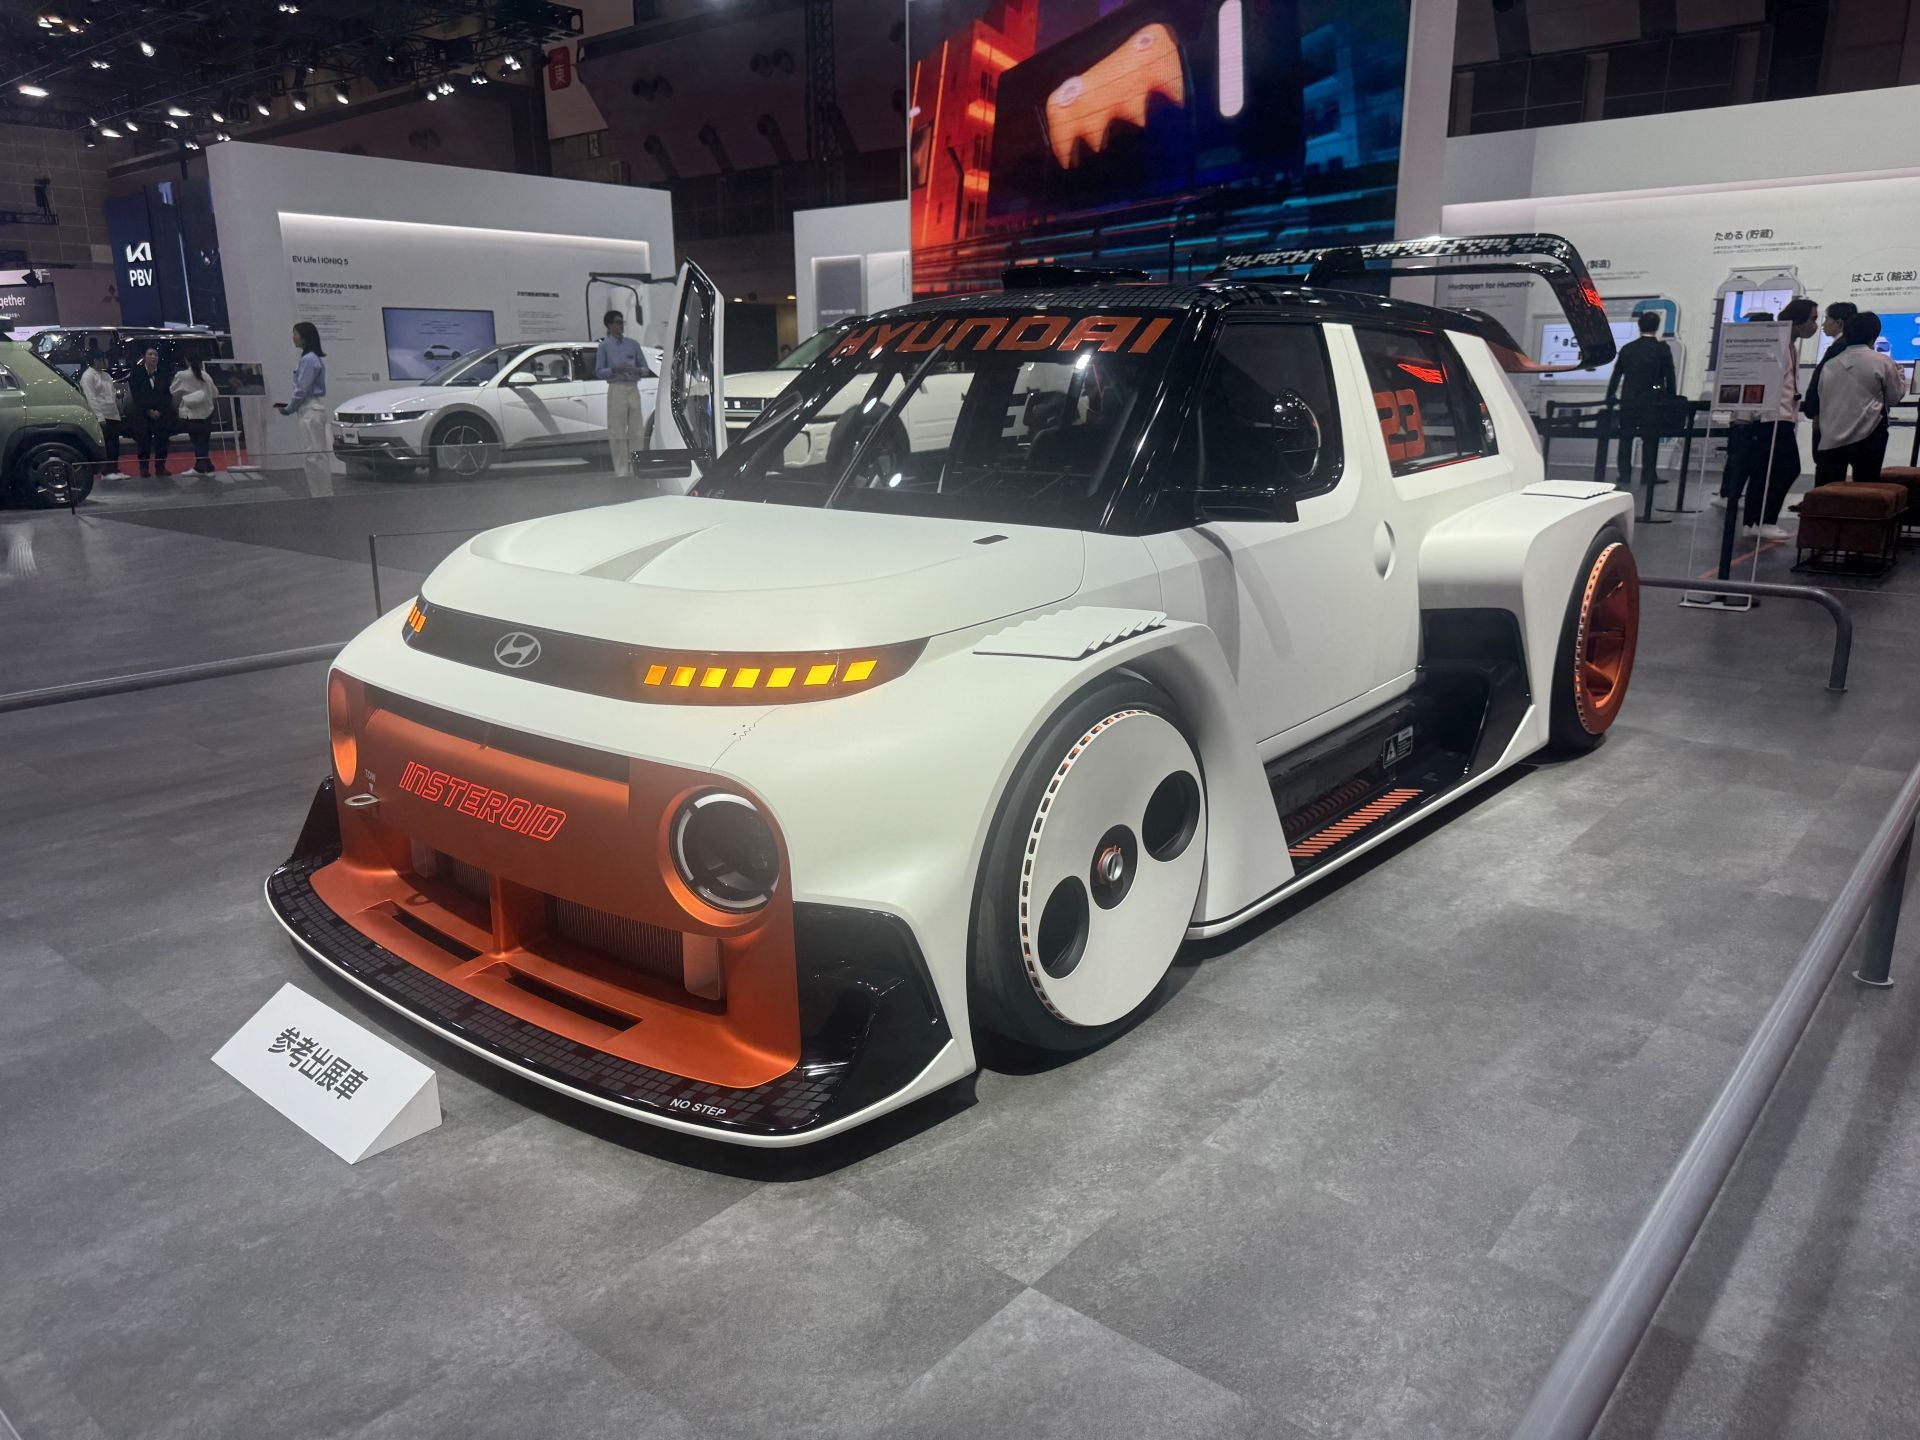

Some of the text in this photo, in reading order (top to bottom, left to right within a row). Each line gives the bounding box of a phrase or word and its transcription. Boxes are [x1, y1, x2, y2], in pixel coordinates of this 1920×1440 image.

[1714, 228, 1774, 242] ためる (貯蔵)
[292, 255, 302, 263] EV
[303, 256, 317, 264] Life
[321, 257, 343, 266] IONIQ
[129, 268, 153, 287] PBV
[1448, 280, 1535, 292] Hydrogen for Humanity
[1851, 270, 1918, 283] はこぶ (輸送)
[828, 315, 1174, 358] HYUNDAI
[399, 760, 568, 842] INSTEROID
[267, 1026, 369, 1103] 参考出展車
[671, 1098, 726, 1117] NO STEP
